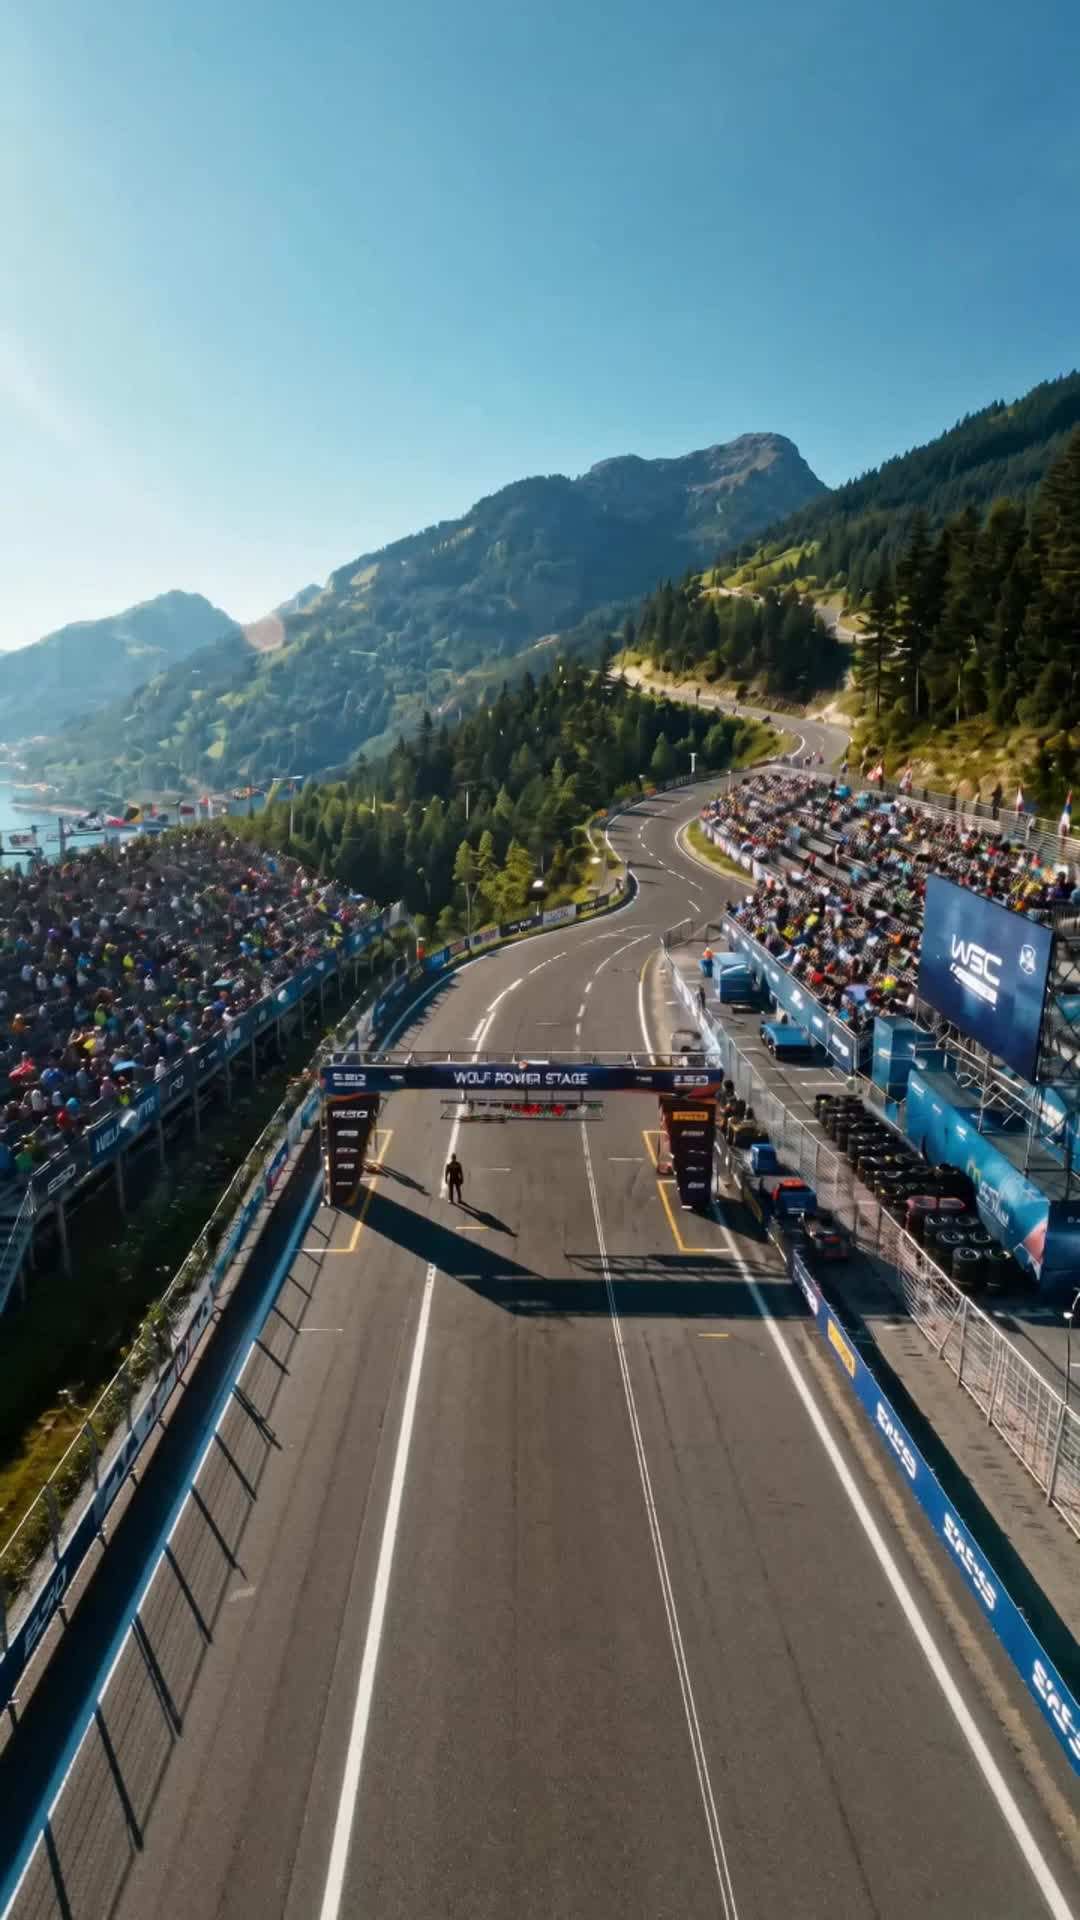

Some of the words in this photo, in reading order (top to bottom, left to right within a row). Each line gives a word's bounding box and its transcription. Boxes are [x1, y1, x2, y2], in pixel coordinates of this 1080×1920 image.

[453, 1072, 491, 1084] WOLF
[495, 1072, 541, 1085] POWER
[545, 1072, 589, 1085] STAGE
